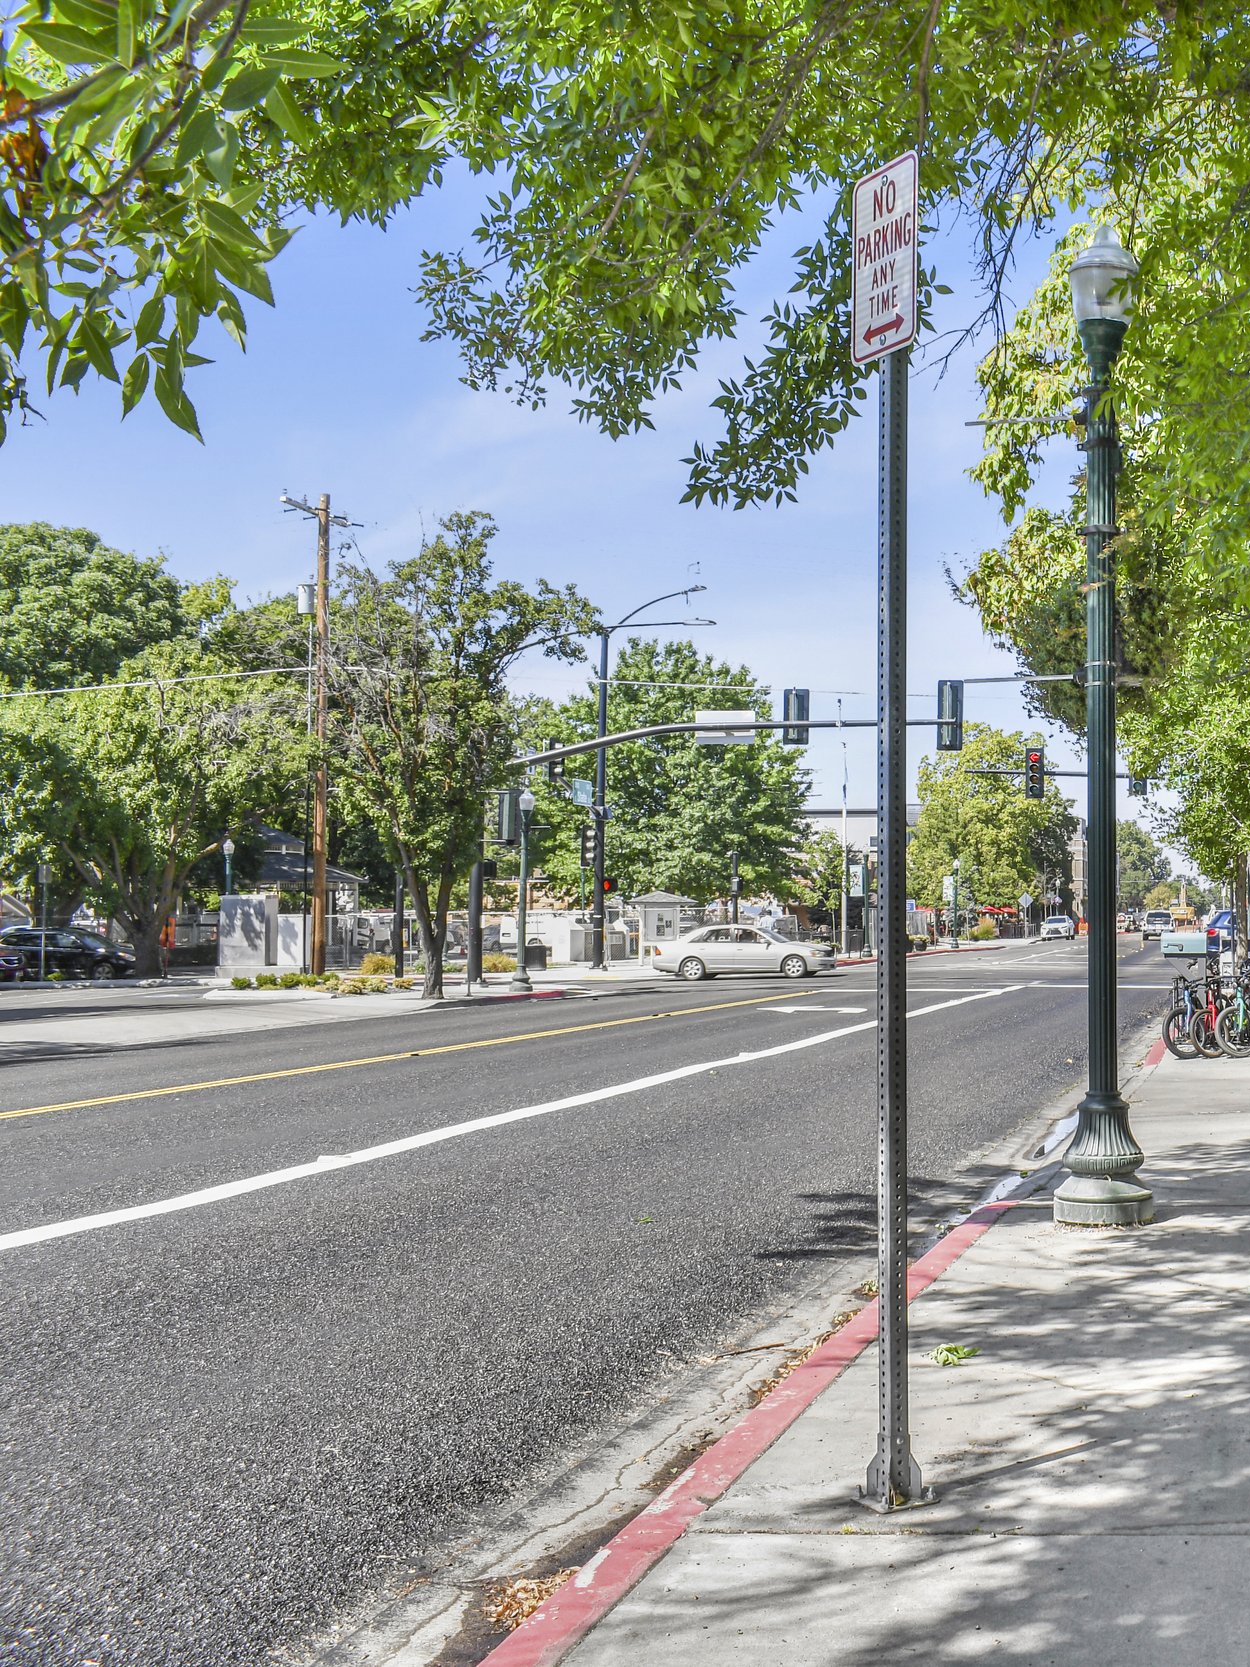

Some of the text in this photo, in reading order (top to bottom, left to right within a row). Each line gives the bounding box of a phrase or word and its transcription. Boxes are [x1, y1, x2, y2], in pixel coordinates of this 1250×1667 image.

[873, 179, 896, 222] NO
[857, 212, 912, 270] PARKING
[871, 258, 896, 291] ANY
[868, 285, 899, 319] TIME
